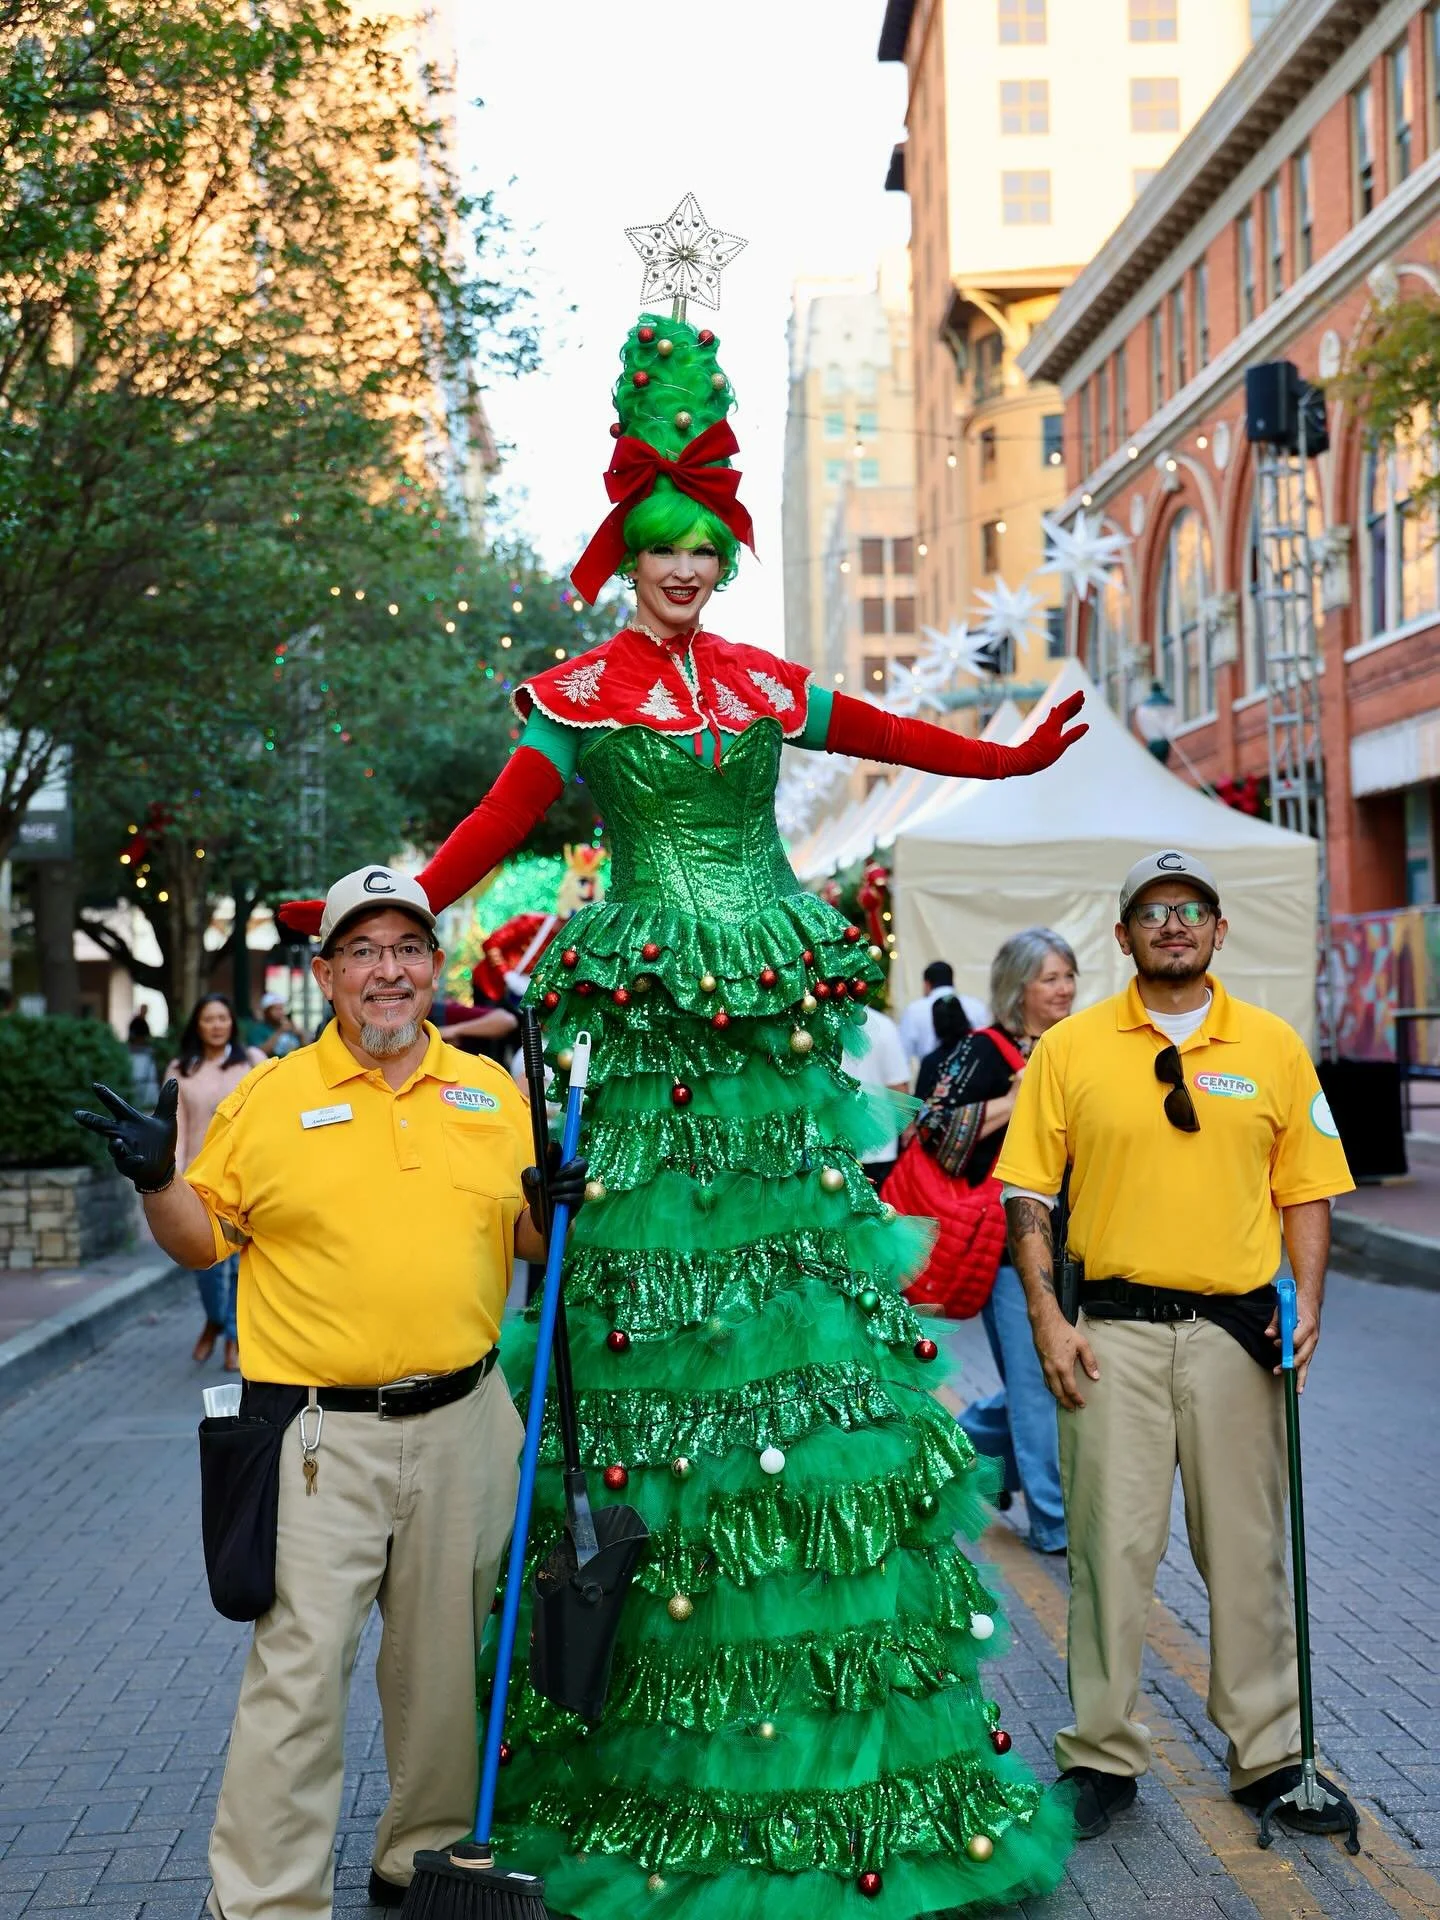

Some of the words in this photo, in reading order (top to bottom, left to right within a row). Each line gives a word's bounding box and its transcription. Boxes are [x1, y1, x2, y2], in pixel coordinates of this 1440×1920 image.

[1157, 853, 1187, 871] C
[363, 871, 397, 894] C
[1199, 1076, 1254, 1093] CENTRO
[445, 1090, 496, 1108] CENTRO
